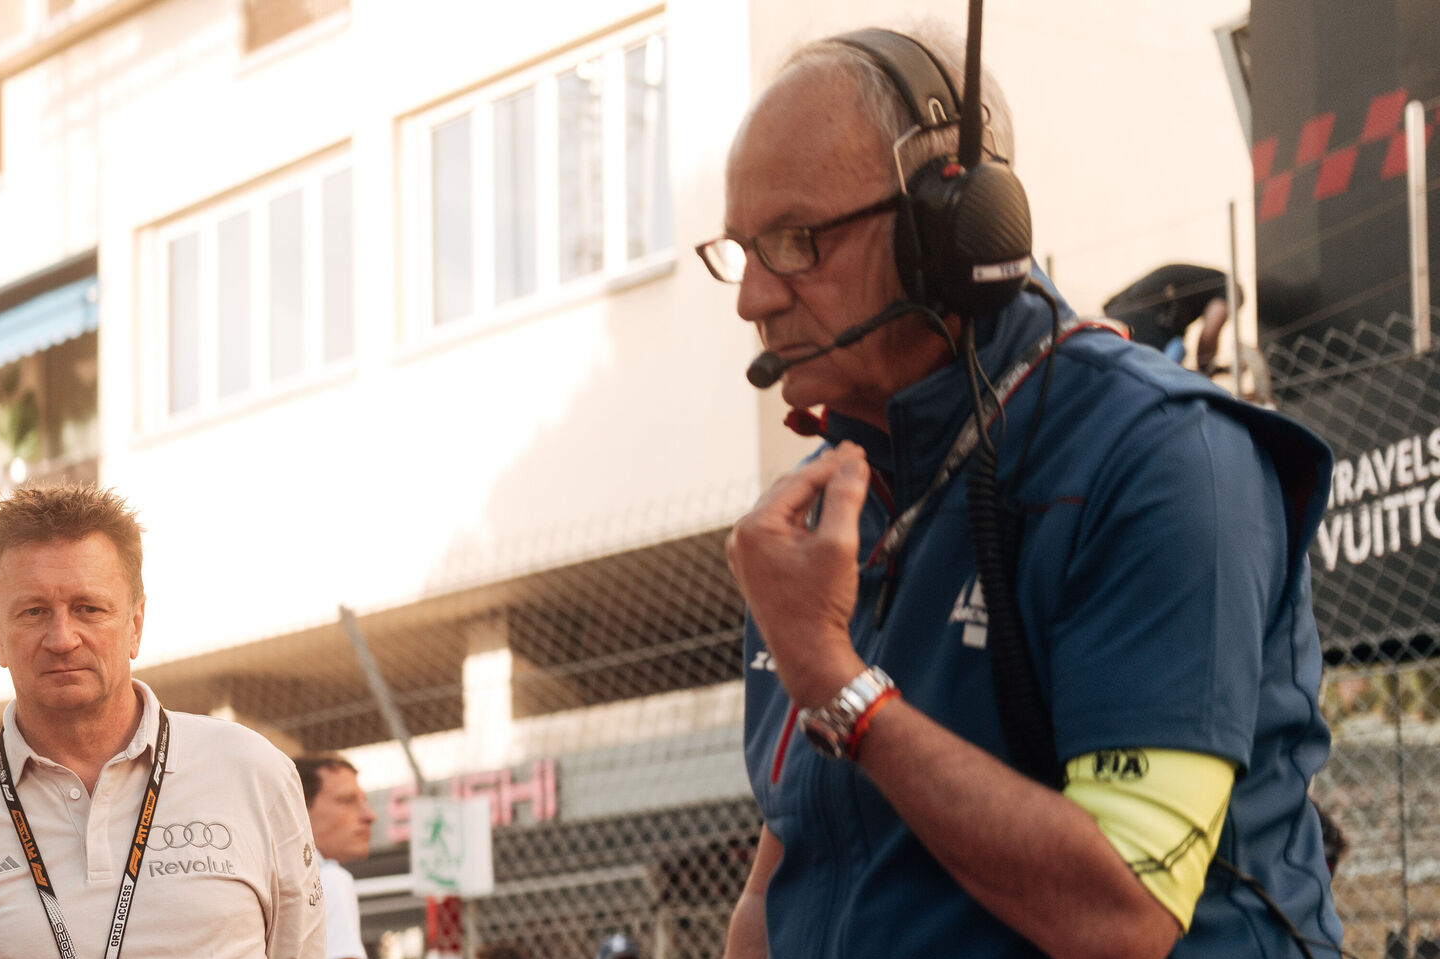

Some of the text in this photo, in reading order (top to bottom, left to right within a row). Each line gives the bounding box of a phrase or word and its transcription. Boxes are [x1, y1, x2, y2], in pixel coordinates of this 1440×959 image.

[1327, 427, 1440, 510] RAVELS
[136, 824, 148, 844] PIT
[148, 856, 237, 878] Revolut
[111, 884, 133, 947] GRID ACCESS
